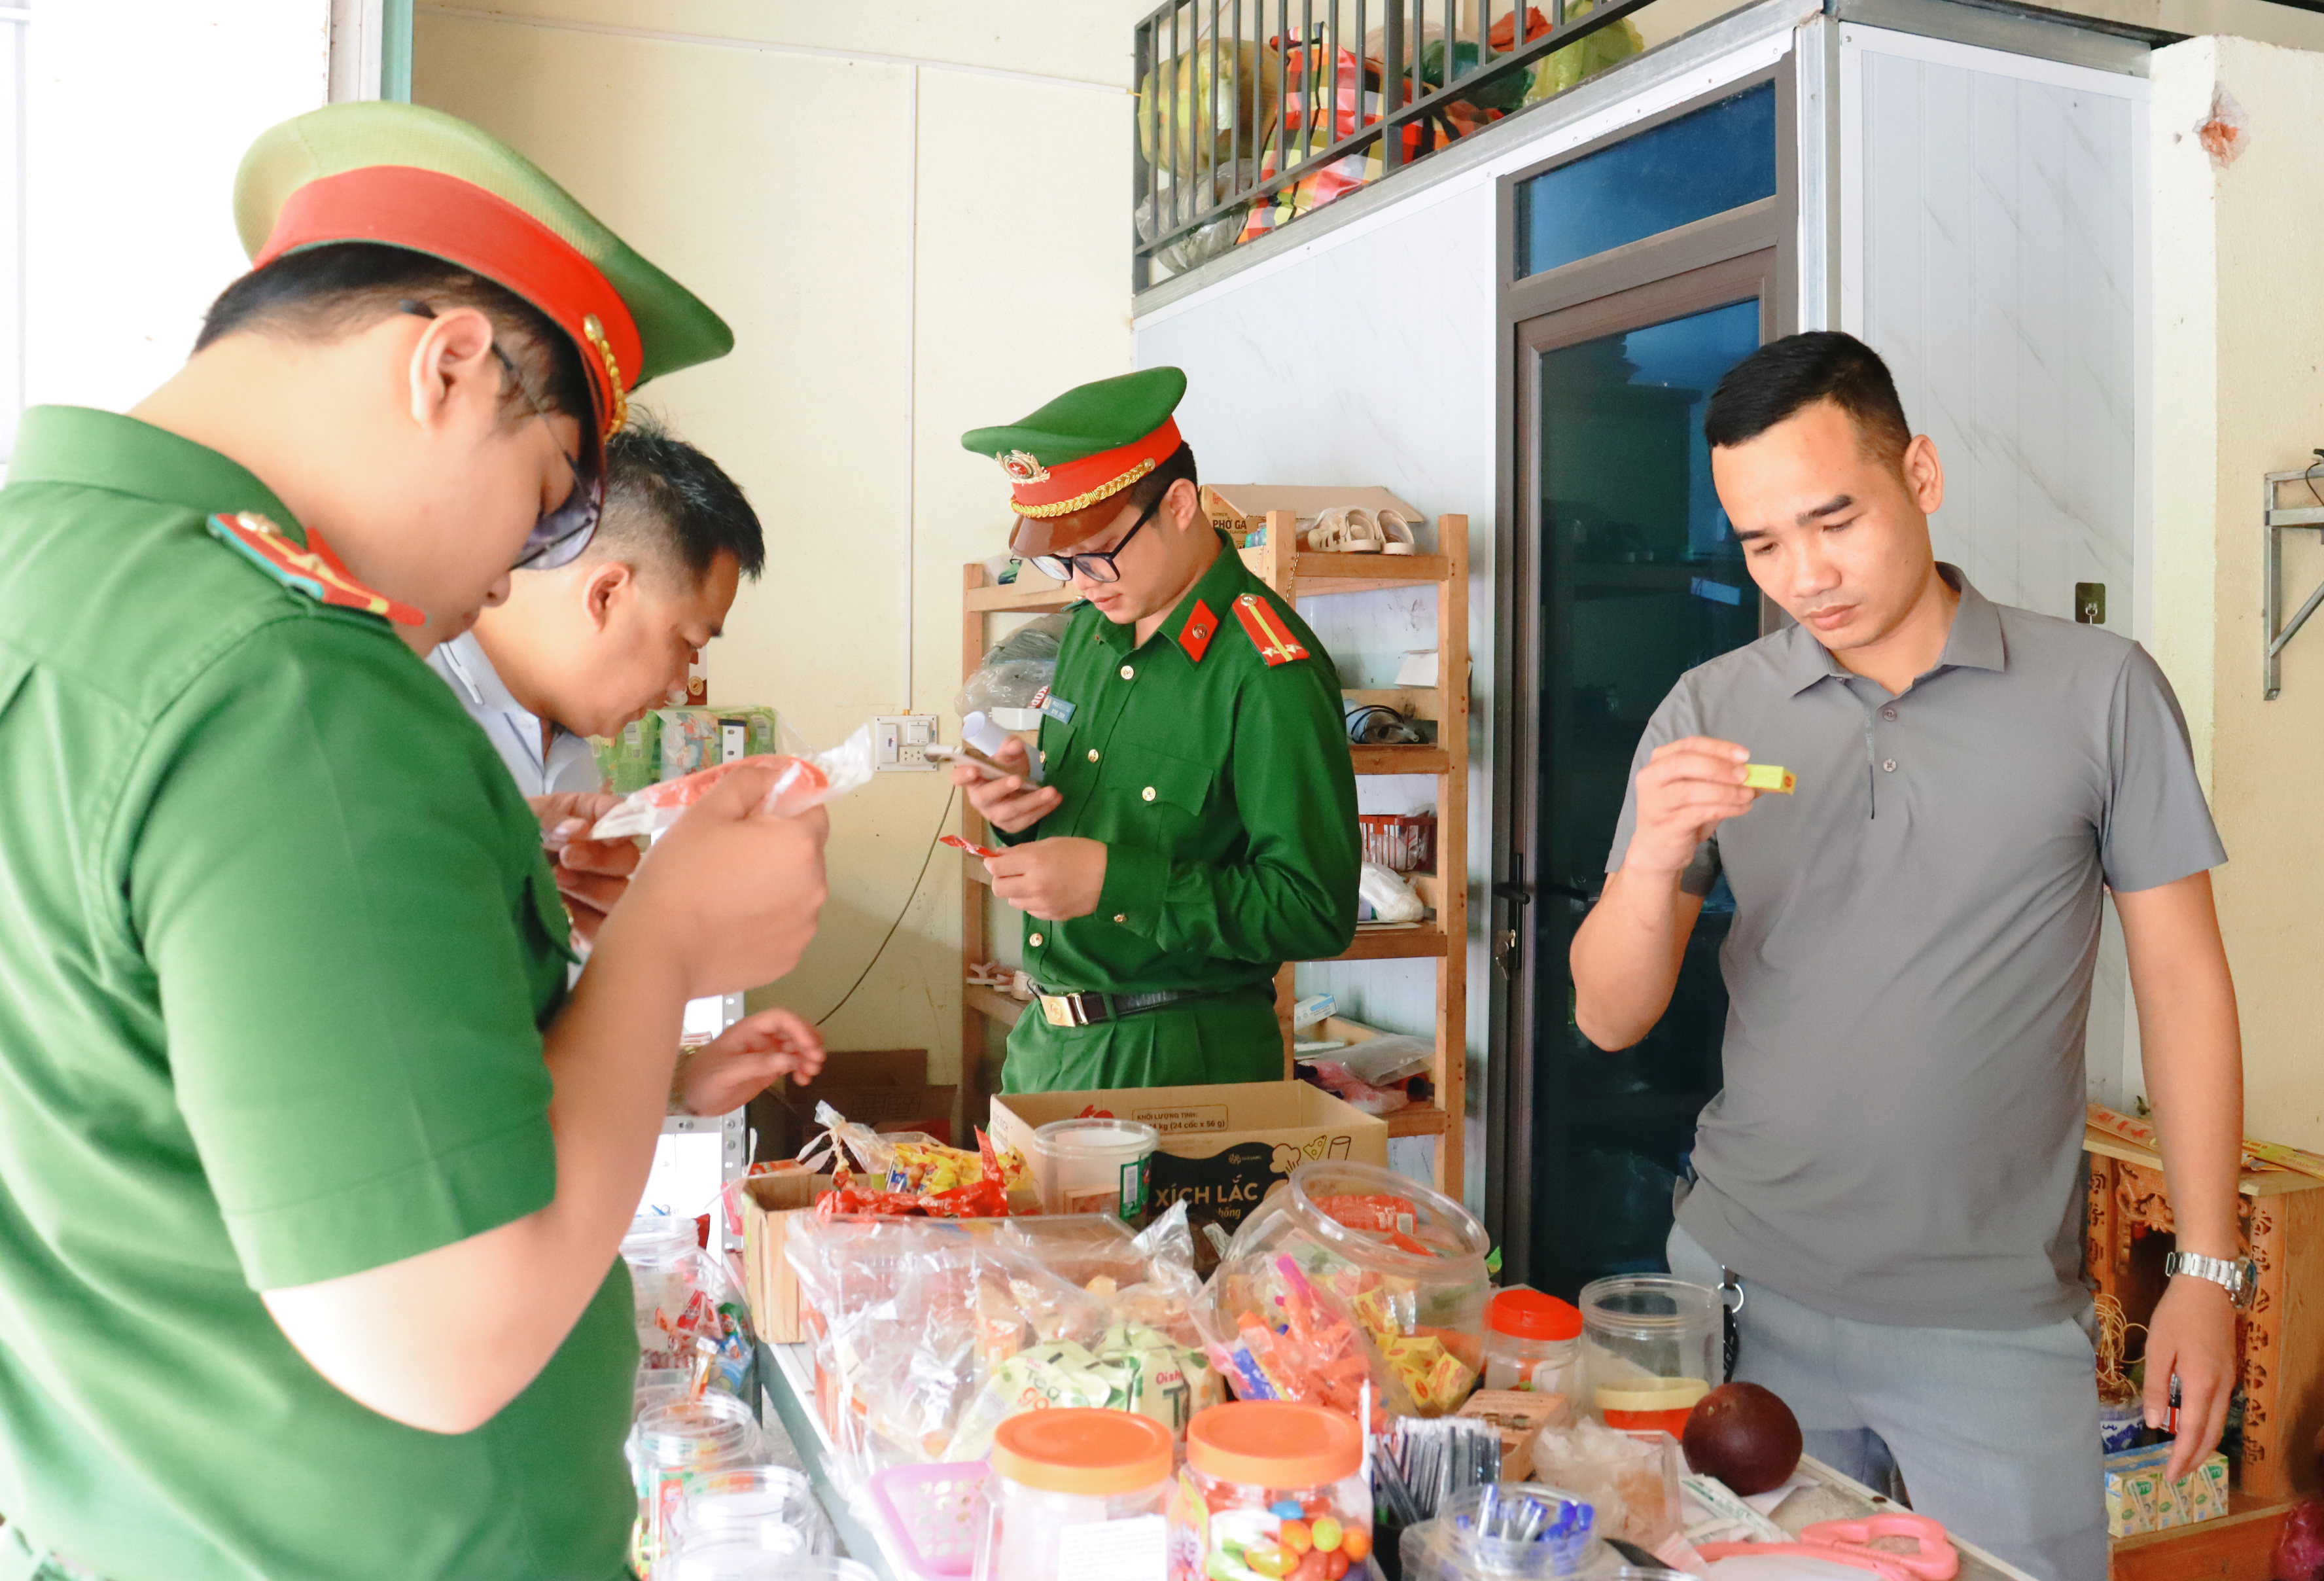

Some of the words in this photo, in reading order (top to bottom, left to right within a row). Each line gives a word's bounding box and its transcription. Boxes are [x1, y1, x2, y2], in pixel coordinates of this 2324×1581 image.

[1170, 1122, 1182, 1130] (24
[1155, 1182, 1210, 1207] XÍCH
[1217, 1174, 1258, 1203] LẮC
